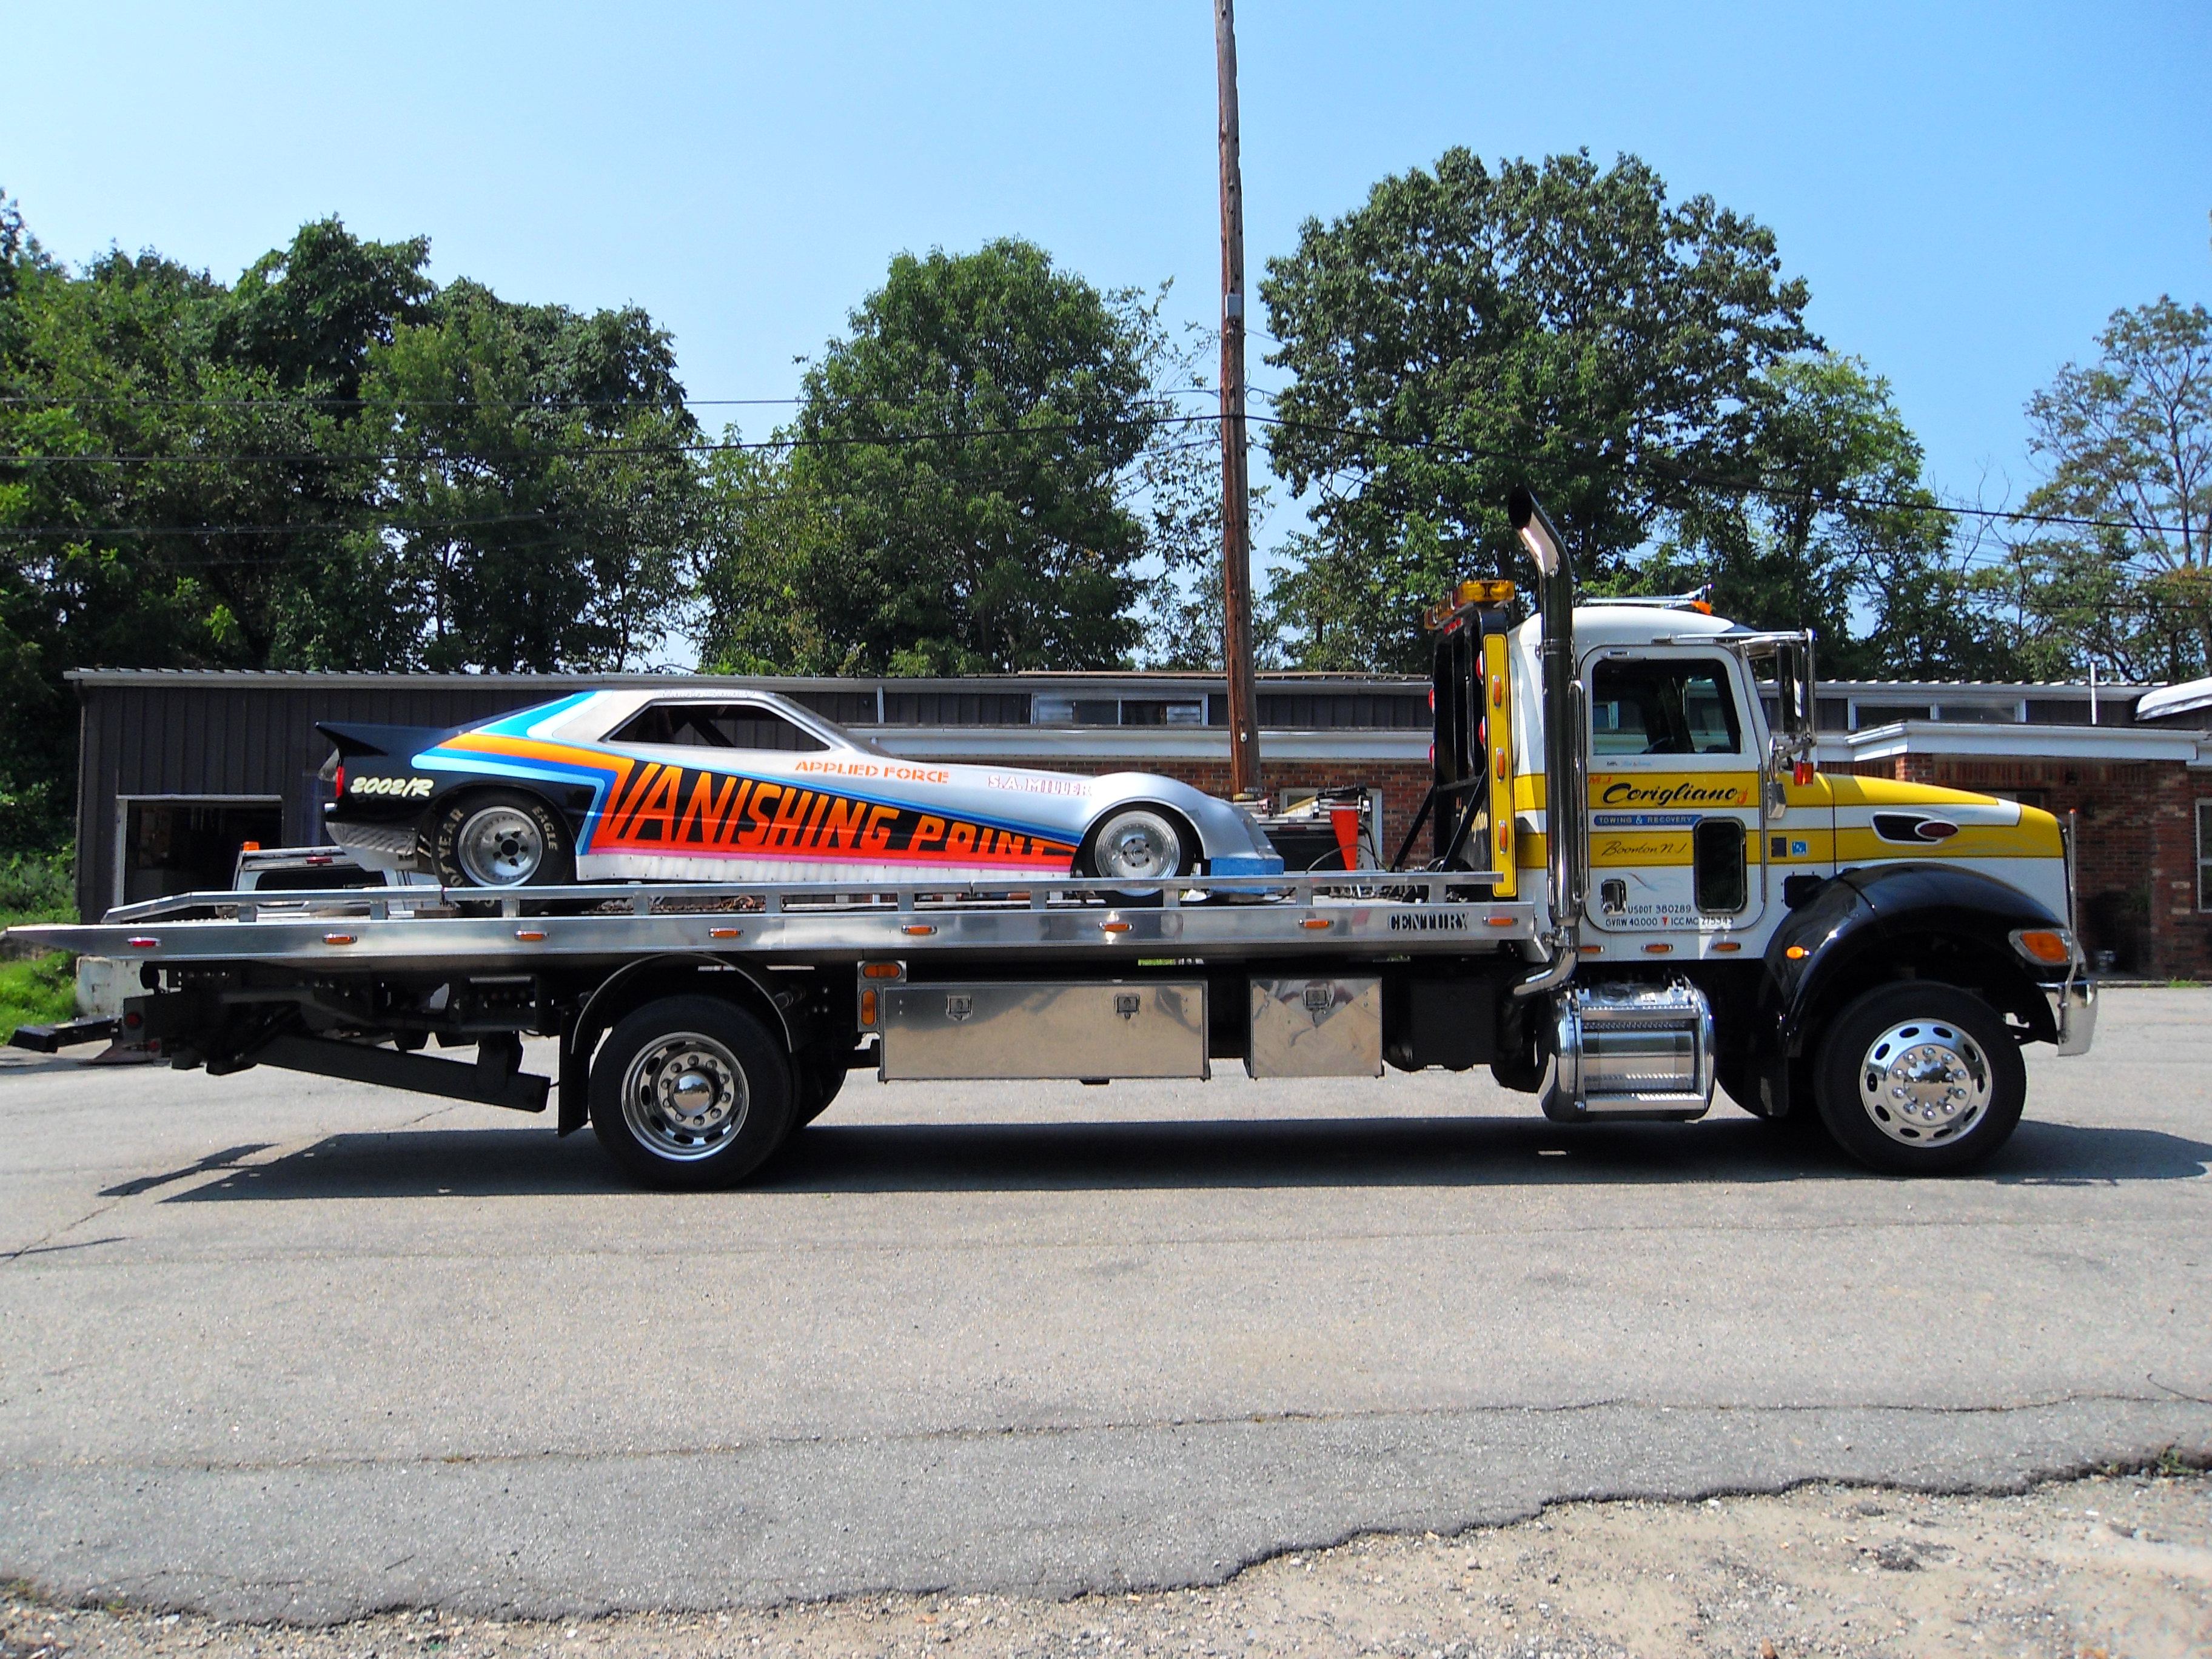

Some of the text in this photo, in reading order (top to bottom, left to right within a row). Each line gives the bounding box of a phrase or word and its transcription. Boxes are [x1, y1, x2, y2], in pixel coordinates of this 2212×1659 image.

[795, 760, 950, 783] APPLIED FORCE
[350, 776, 434, 797] 2002/R
[988, 775, 1092, 796] S.A. MILLER
[1602, 782, 1738, 805] Corigliano
[592, 759, 1078, 856] VANISHING POINT
[532, 806, 558, 851] EAGLE
[1635, 816, 1643, 824] &
[1627, 904, 1691, 914] USDOT 380289
[1387, 912, 1469, 931] CENTURY
